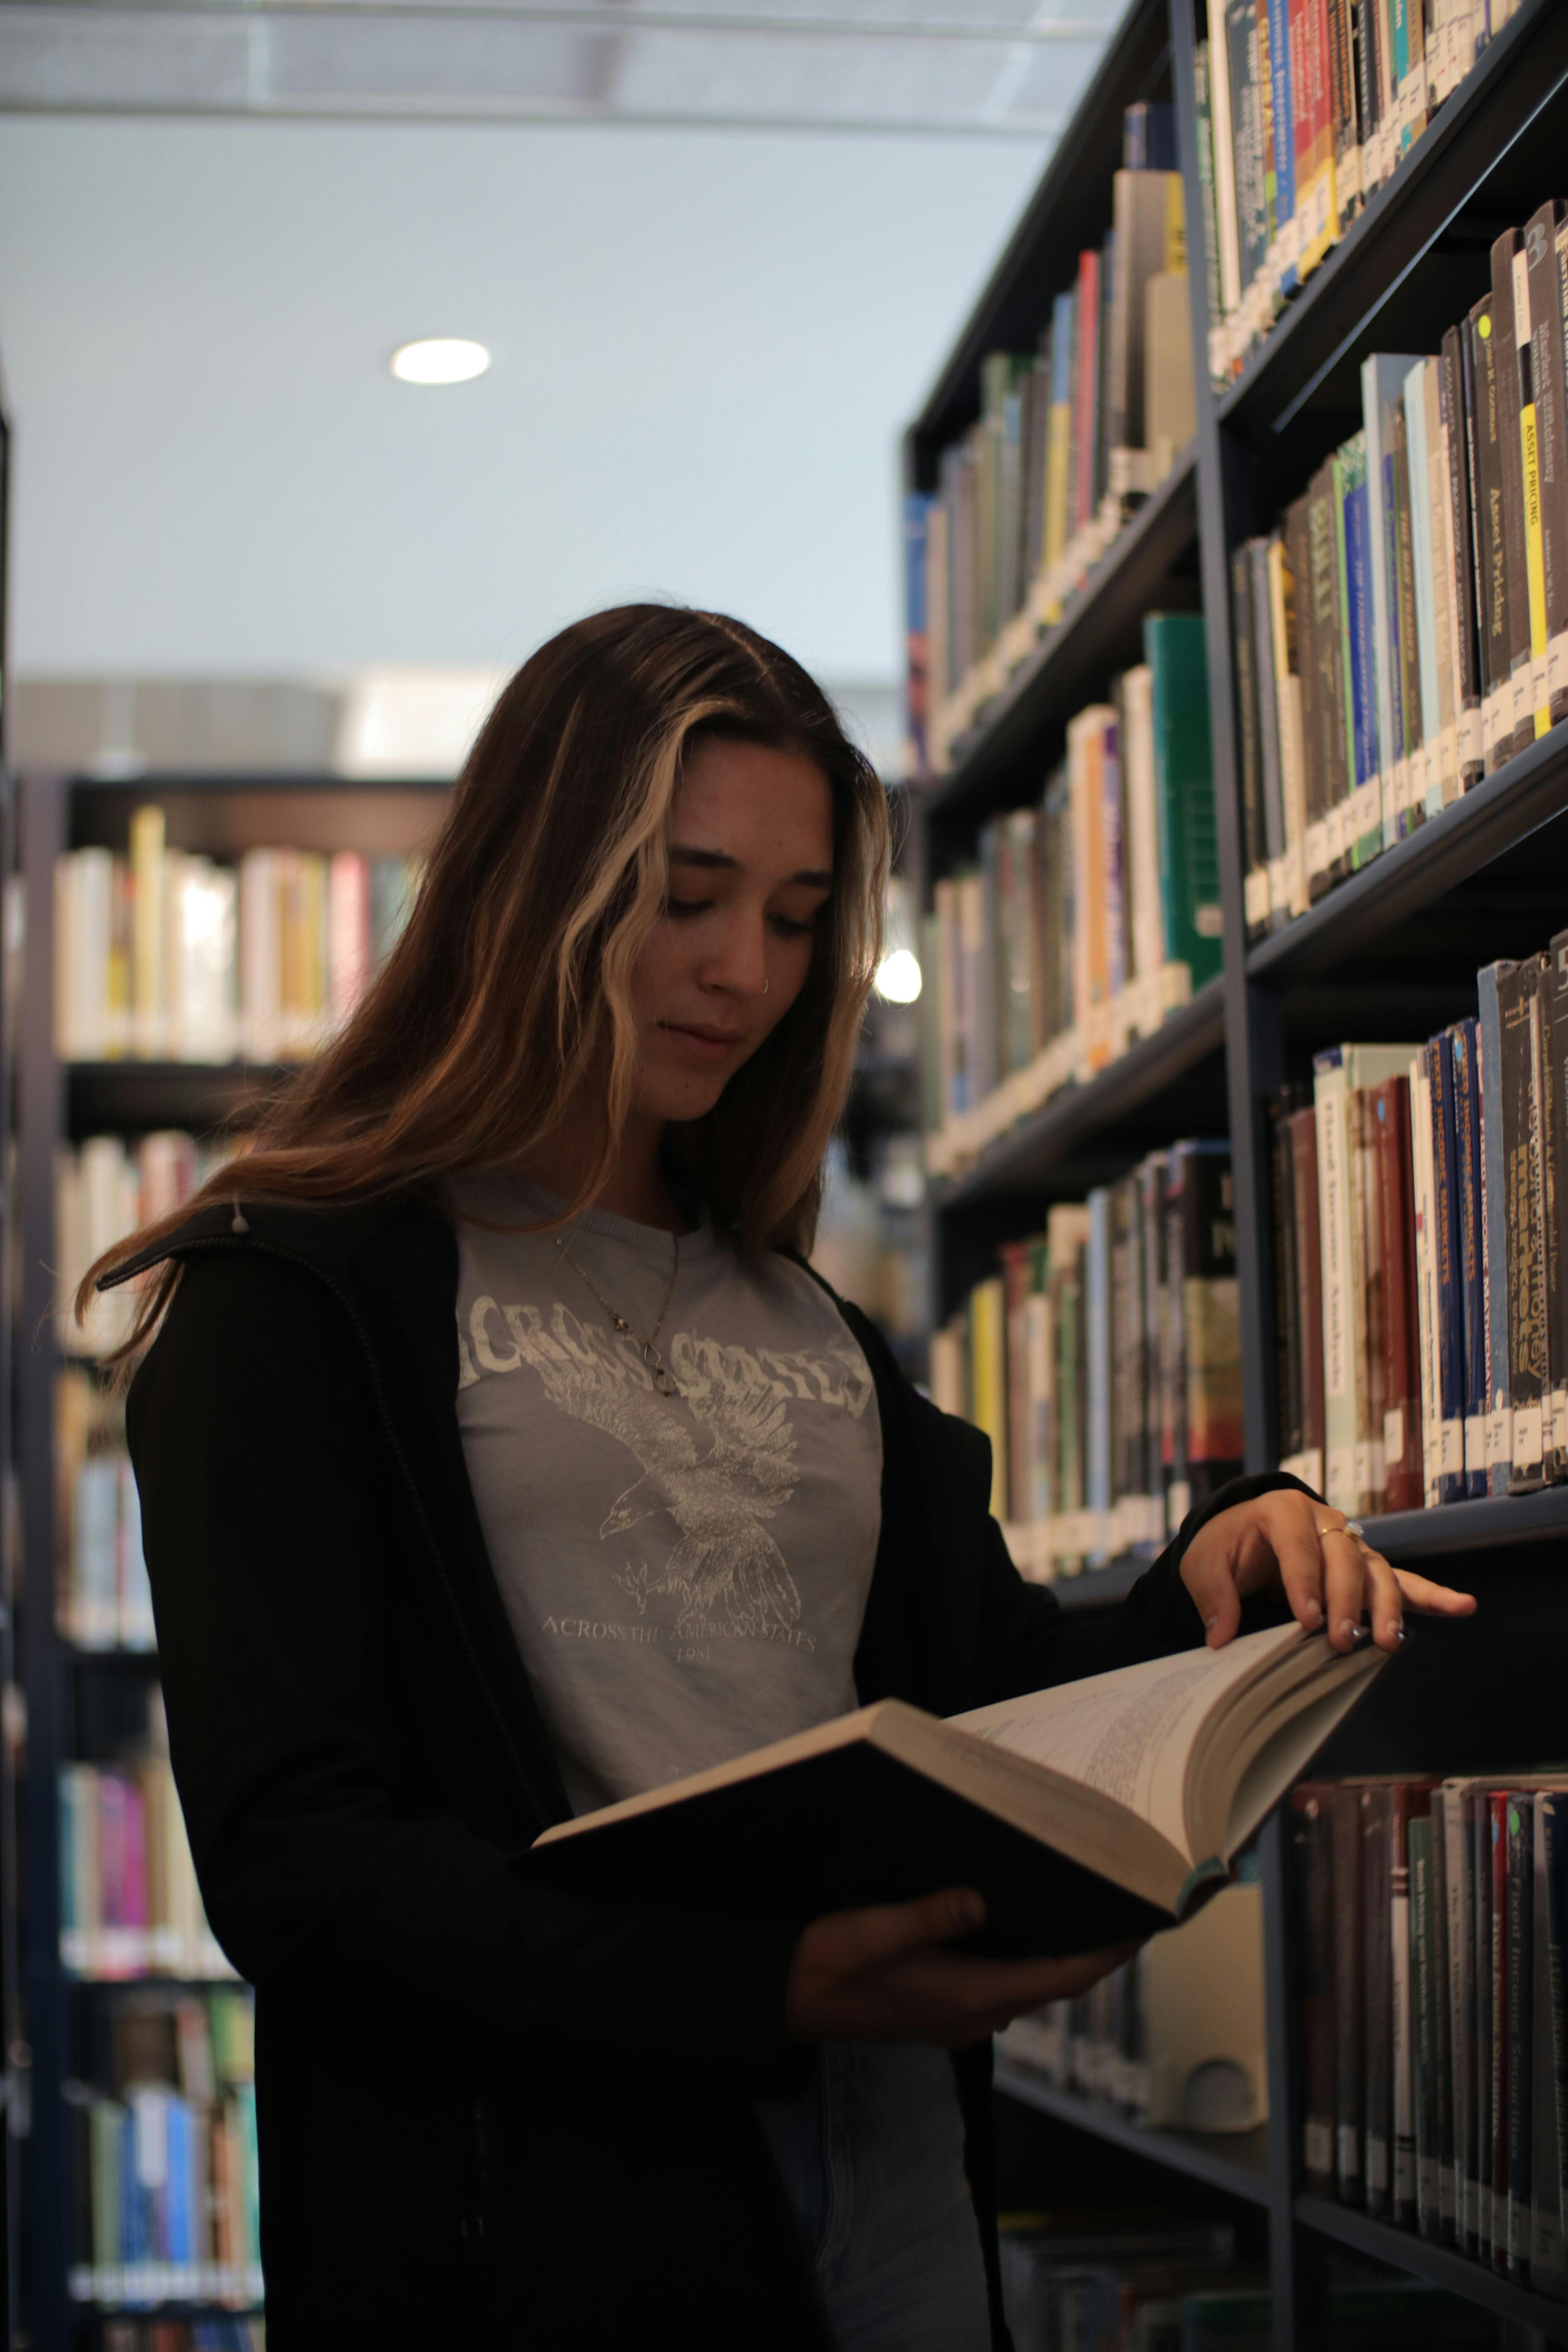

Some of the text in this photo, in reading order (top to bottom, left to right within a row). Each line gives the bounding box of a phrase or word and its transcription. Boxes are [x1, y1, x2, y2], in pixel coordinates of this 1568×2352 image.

[1532, 330, 1541, 398] VOLUME
[1539, 320, 1554, 483] Market Efficiency
[1526, 425, 1539, 526] ASSET PRICING
[1452, 476, 1461, 554] PARADOX
[1459, 626, 1467, 687] PRICING
[1490, 488, 1504, 637] Asset Pricing
[1434, 1040, 1450, 1285] FIXED INCOME MARKETS
[1463, 1099, 1472, 1177] INCOME
[1465, 1182, 1475, 1282] MARKETS
[1517, 1144, 1533, 1374] markets
[1528, 1258, 1544, 1379] money
[541, 1614, 626, 1641] ACROSS
[670, 1621, 757, 1641] AMERICAN
[760, 1623, 817, 1653] STATES
[1510, 1877, 1522, 2161] Fixed Income Securities
